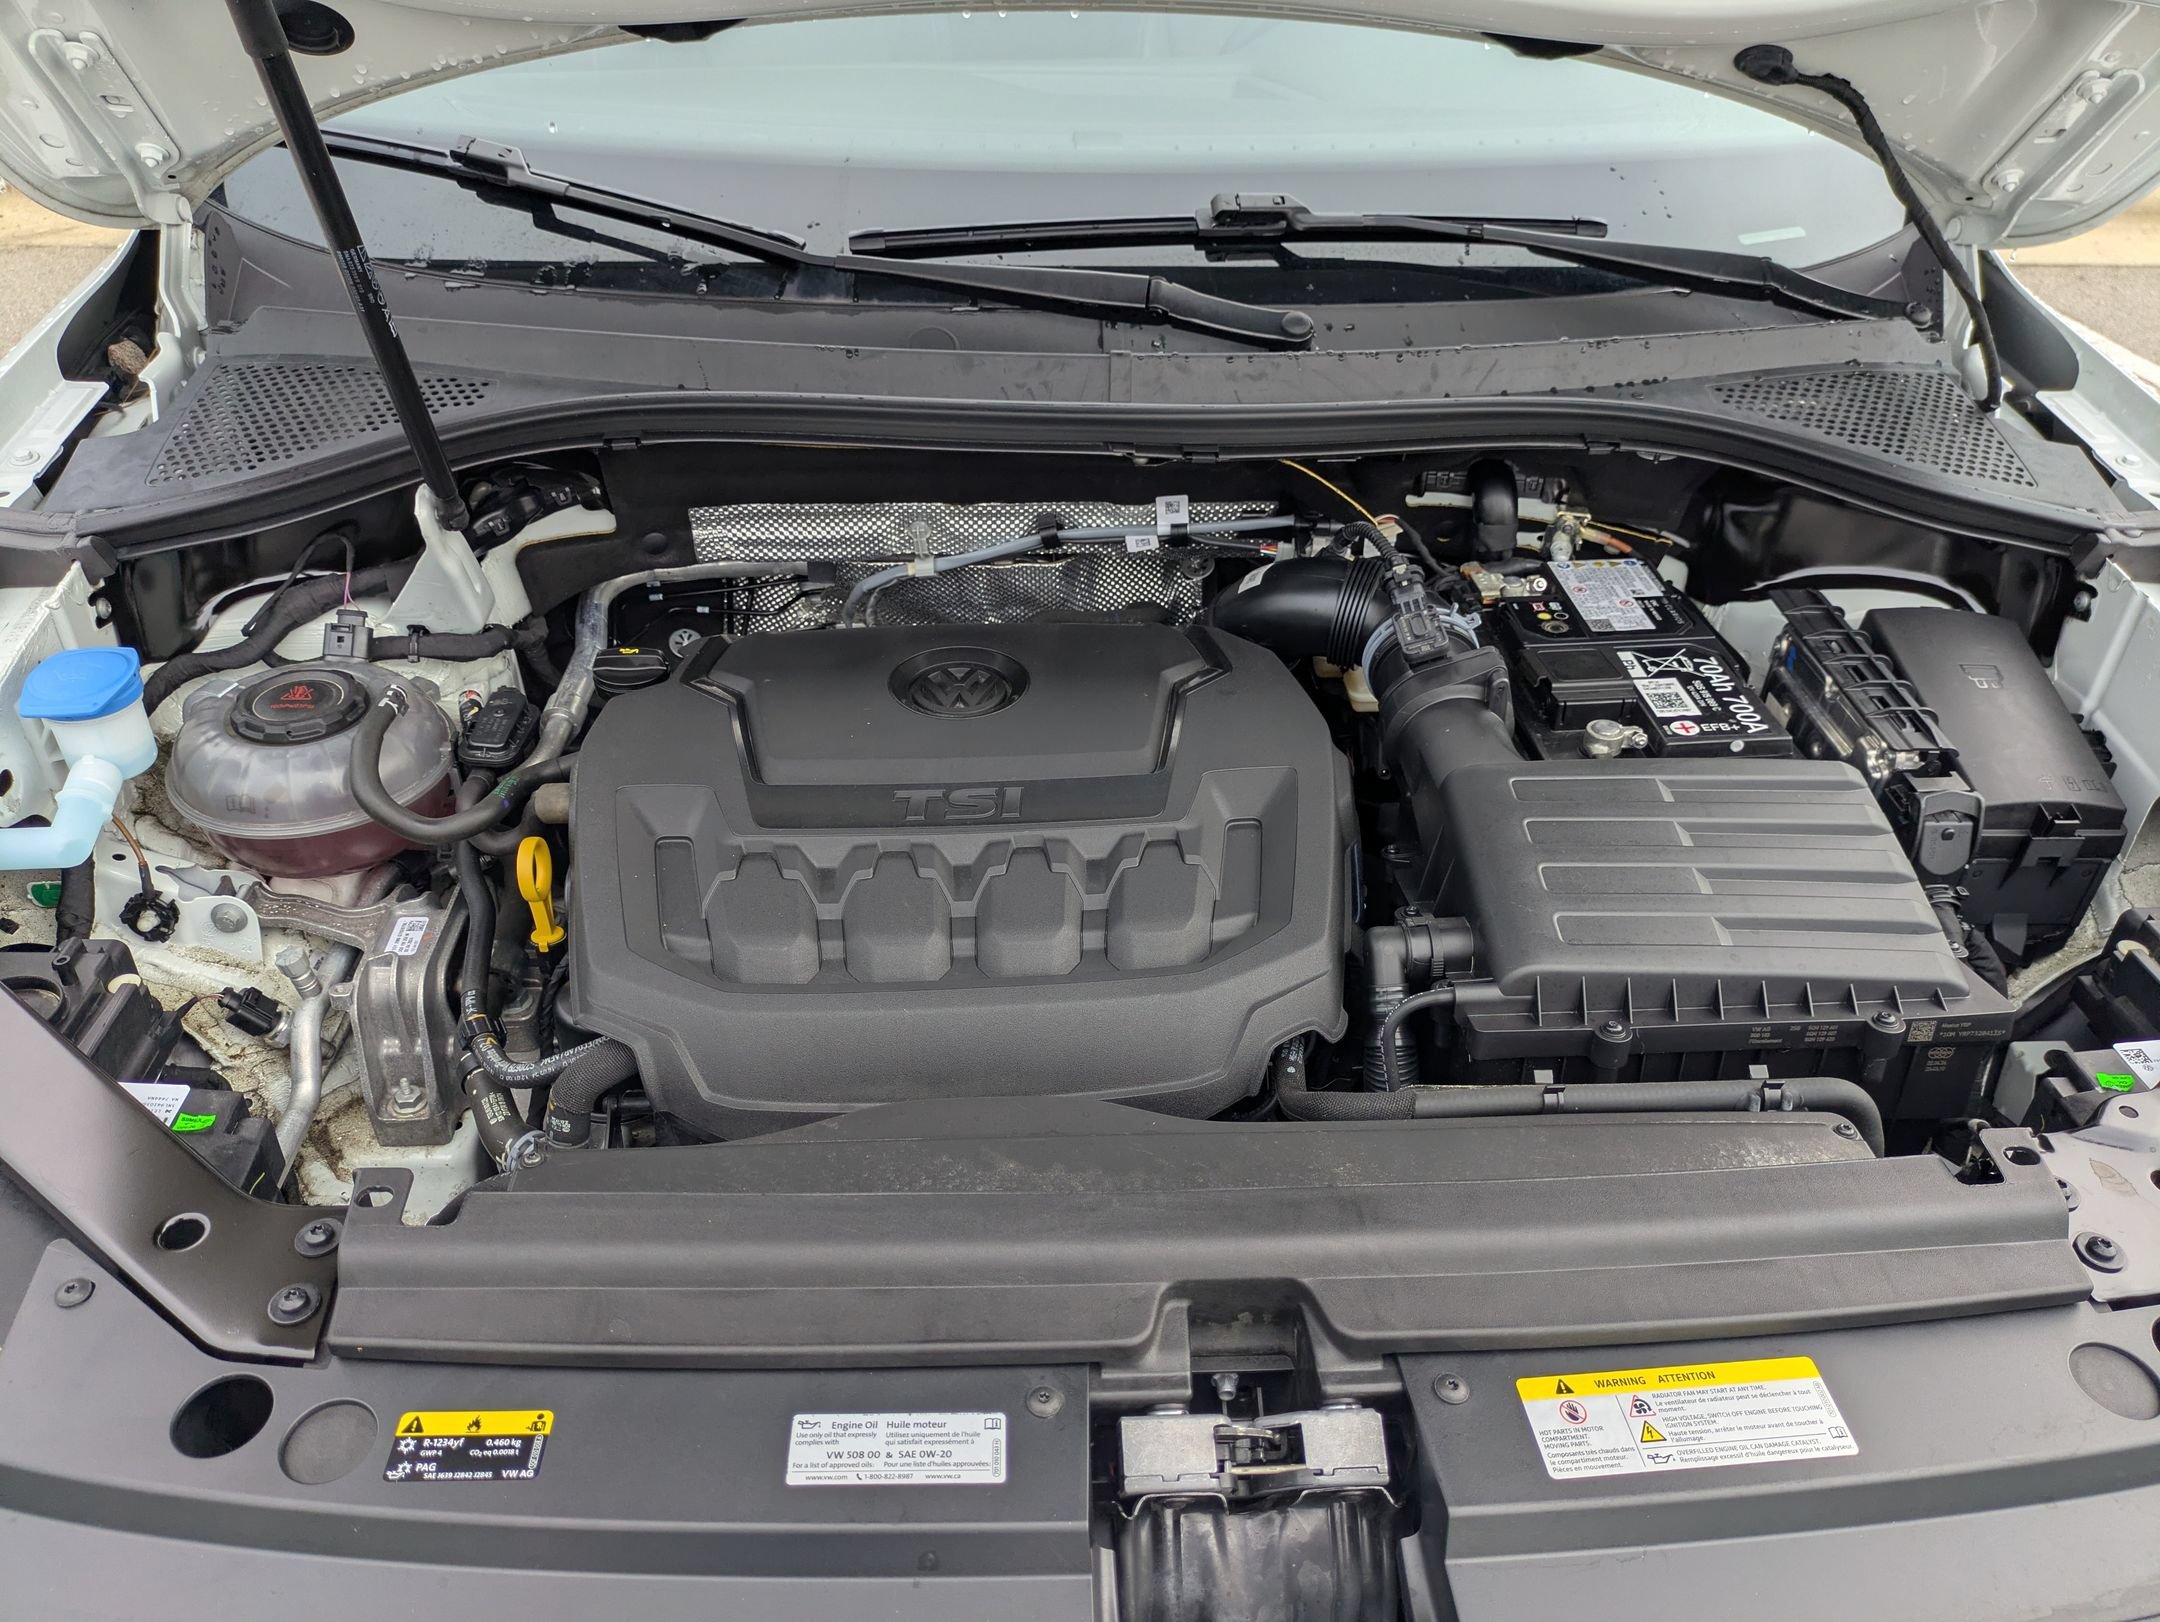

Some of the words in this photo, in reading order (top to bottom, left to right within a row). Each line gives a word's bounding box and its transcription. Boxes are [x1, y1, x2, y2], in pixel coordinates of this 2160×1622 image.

[1693, 657, 1734, 692] 70Ah
[1723, 695, 1768, 733] 700A
[1700, 722, 1740, 732] EFB+
[893, 787, 1024, 821] TSI
[1594, 1376, 1646, 1388] WARNING
[1658, 1371, 1715, 1383] ATTENTION
[1664, 1398, 1697, 1406] ventilateur
[1744, 1408, 1767, 1416] ENGINE
[1792, 1404, 1823, 1412] TOUCHING
[832, 1421, 862, 1431] Engine
[865, 1421, 878, 1429] Oil
[887, 1421, 910, 1429] Huile
[913, 1421, 947, 1429] moteur
[423, 1438, 465, 1450] R-1234yf
[486, 1439, 510, 1447] 0.460
[511, 1438, 522, 1448] kg
[795, 1439, 822, 1447] complies
[885, 1439, 894, 1447] qui
[924, 1438, 969, 1446] expressément
[483, 1450, 492, 1458] eq
[826, 1451, 844, 1459] VW
[846, 1451, 865, 1459] 508
[867, 1451, 881, 1459] 00
[886, 1451, 893, 1459] &
[898, 1450, 916, 1458] SAE
[919, 1450, 952, 1458] 0W-20
[1547, 1450, 1585, 1459] Composants
[1677, 1448, 1714, 1456] OVERFILLED
[1558, 1456, 1602, 1465] compartiment
[1680, 1454, 1719, 1463] Remplissage
[1720, 1452, 1744, 1460] excessif
[415, 1463, 437, 1472] PAG
[502, 1470, 519, 1478] VW
[519, 1469, 534, 1478] AG
